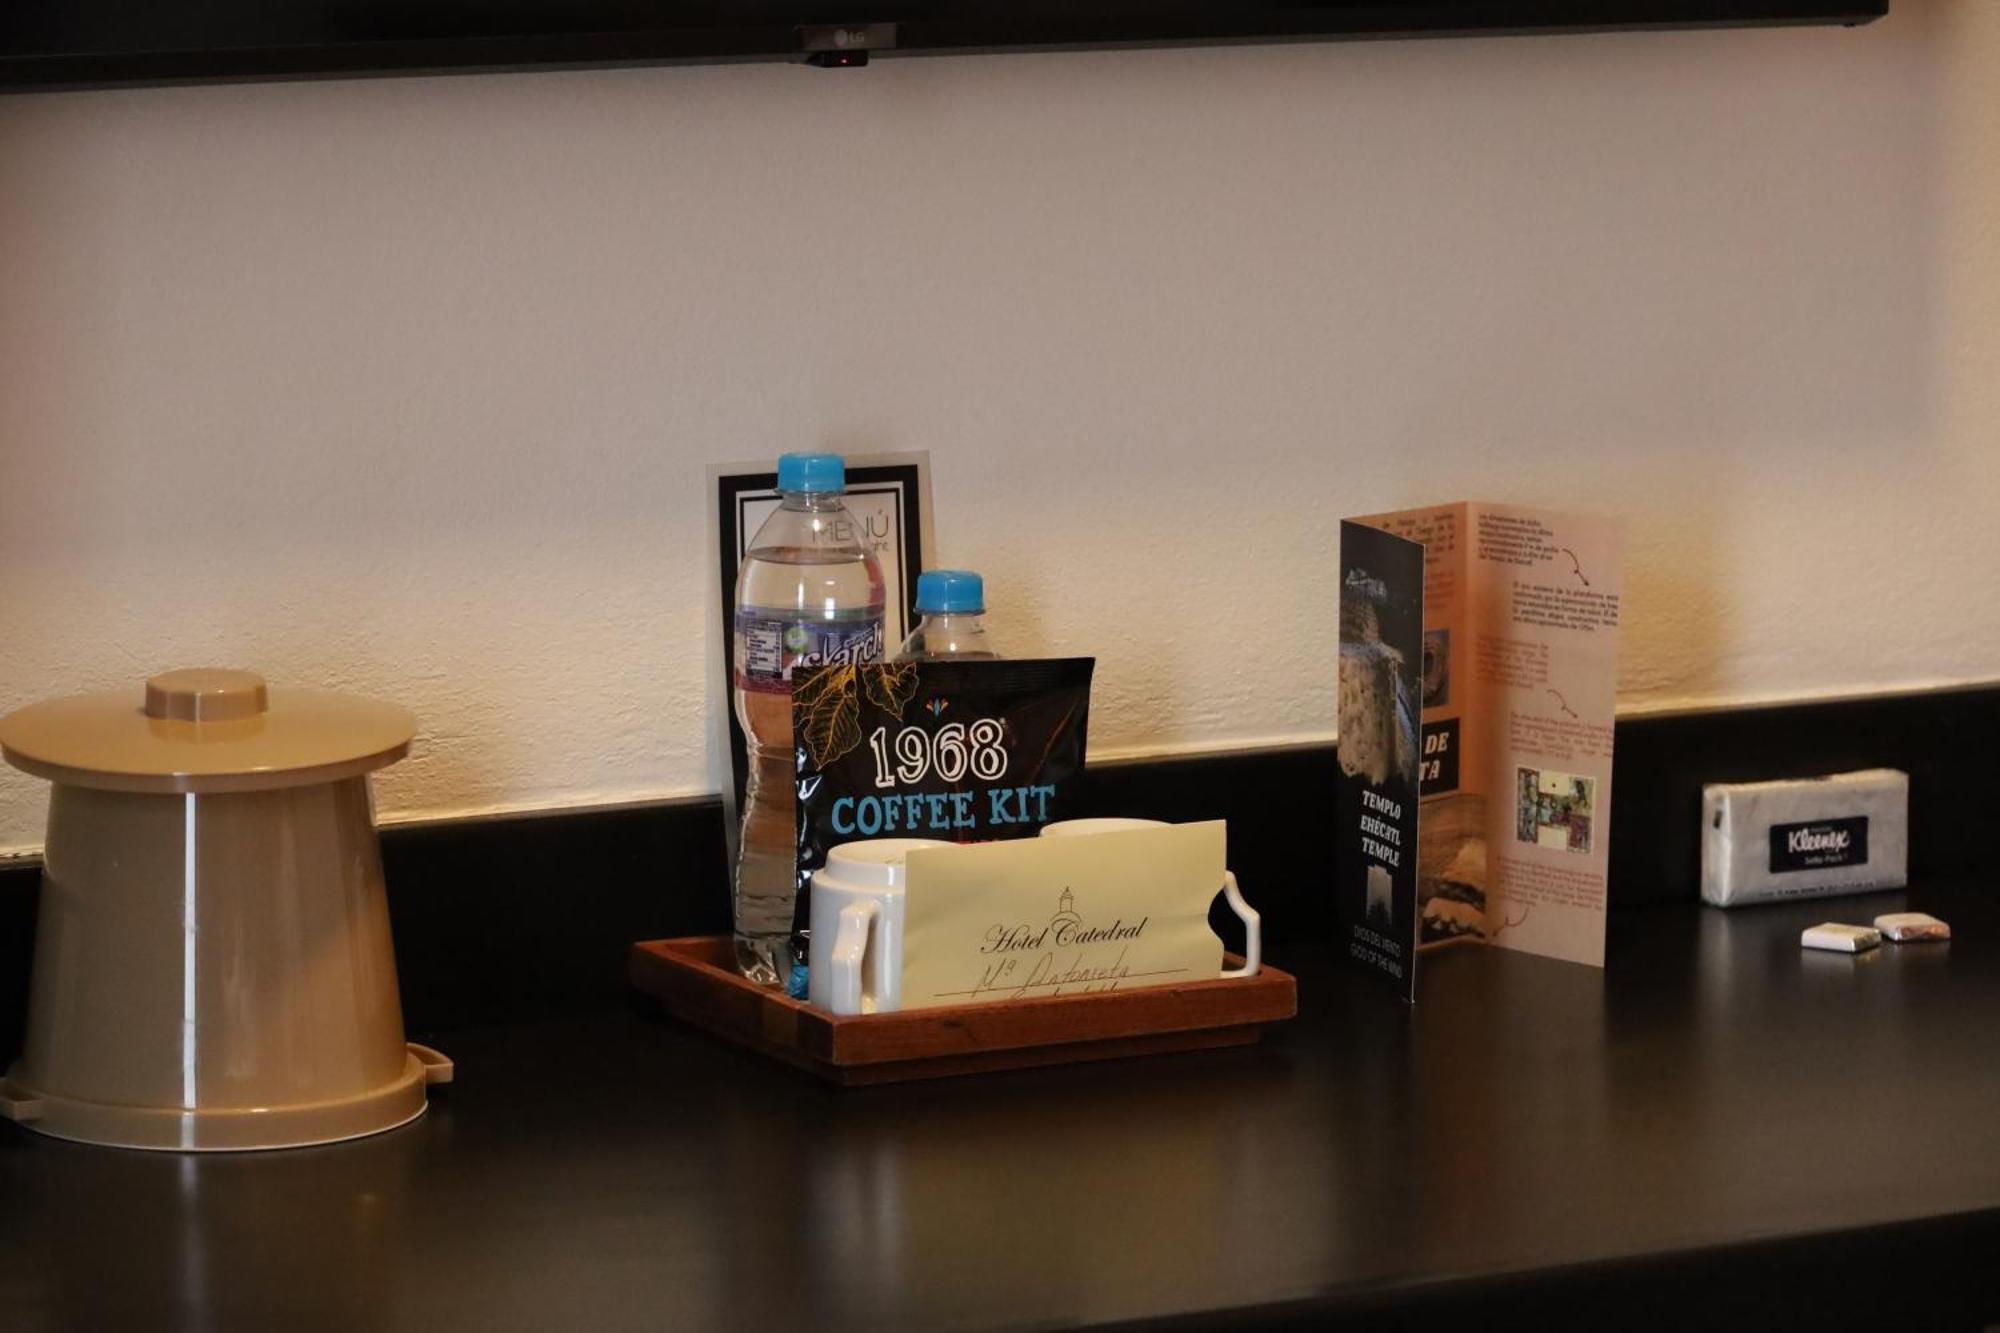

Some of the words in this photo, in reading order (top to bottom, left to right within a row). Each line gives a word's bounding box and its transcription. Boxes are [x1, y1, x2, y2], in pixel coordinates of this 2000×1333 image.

[870, 718, 1008, 788] 1968
[1425, 732, 1450, 754] DE
[1419, 759, 1440, 781] TA
[831, 792, 976, 836] COFFEE
[988, 784, 1056, 826] KIT
[1362, 789, 1401, 820] TEMPLO
[1362, 837, 1400, 867] TEMPLE
[1788, 828, 1850, 853] Kleenex
[980, 925, 1050, 953] Hotel
[1051, 916, 1149, 948] Catedral
